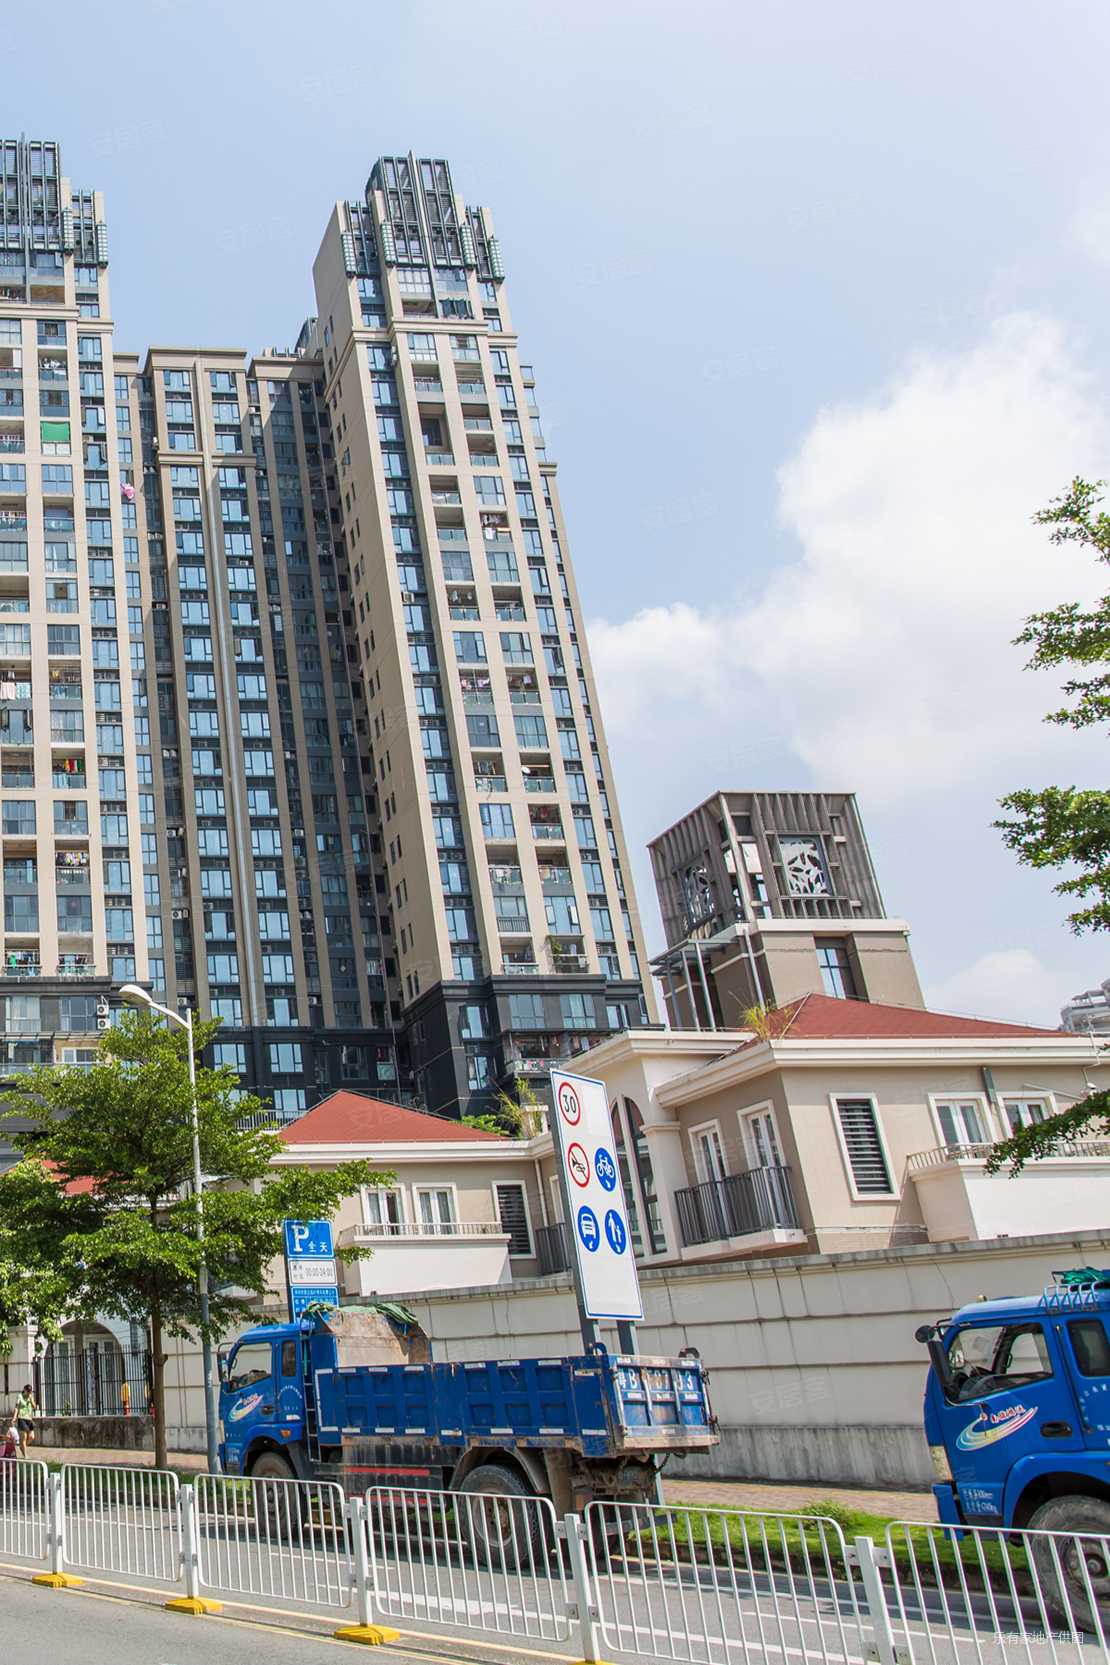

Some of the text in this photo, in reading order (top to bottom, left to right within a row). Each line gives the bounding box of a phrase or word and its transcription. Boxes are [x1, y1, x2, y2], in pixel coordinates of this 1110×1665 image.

[562, 1093, 578, 1115] 30
[291, 1225, 328, 1253] P 全天
[305, 1267, 333, 1277] 00:00-24:00
